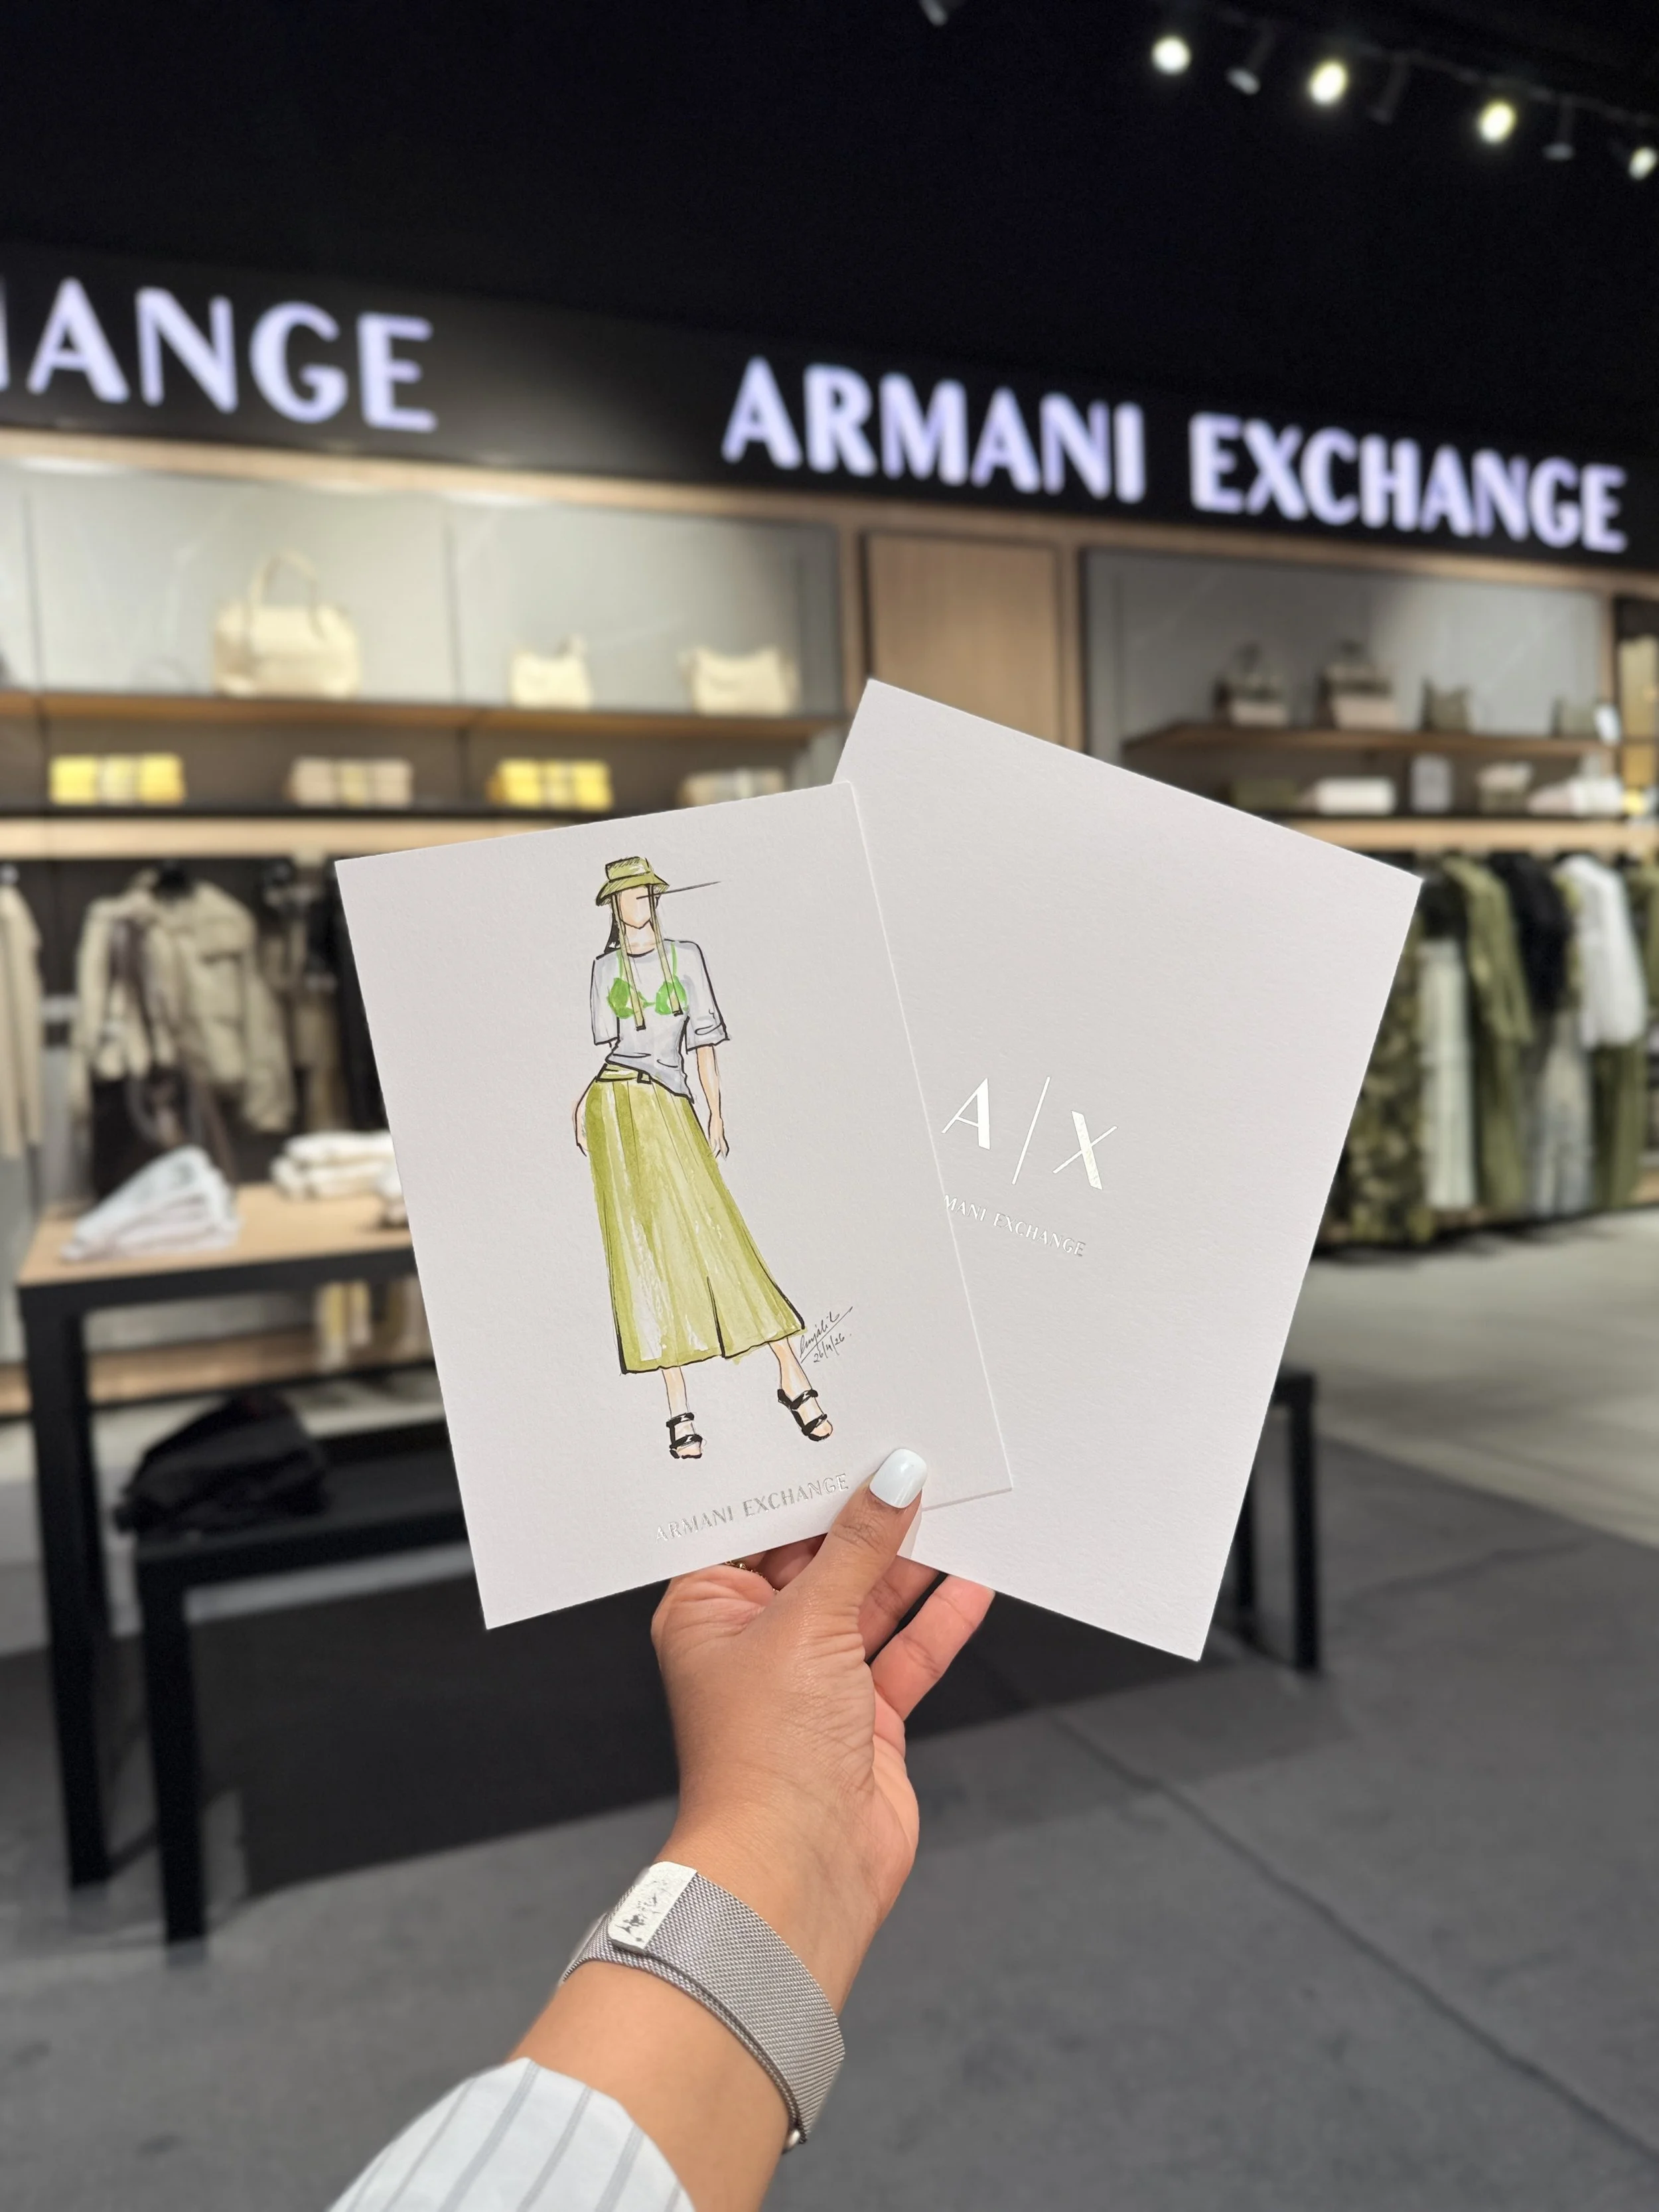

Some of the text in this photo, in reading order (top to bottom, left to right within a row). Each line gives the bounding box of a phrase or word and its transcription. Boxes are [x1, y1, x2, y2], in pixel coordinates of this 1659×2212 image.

[0, 277, 438, 434] ANGE
[722, 357, 1625, 552] ARMANI EXCHANGE
[993, 1212, 1086, 1257] EXCHANGE
[654, 1473, 849, 1544] ARMANI EXCHANGE
